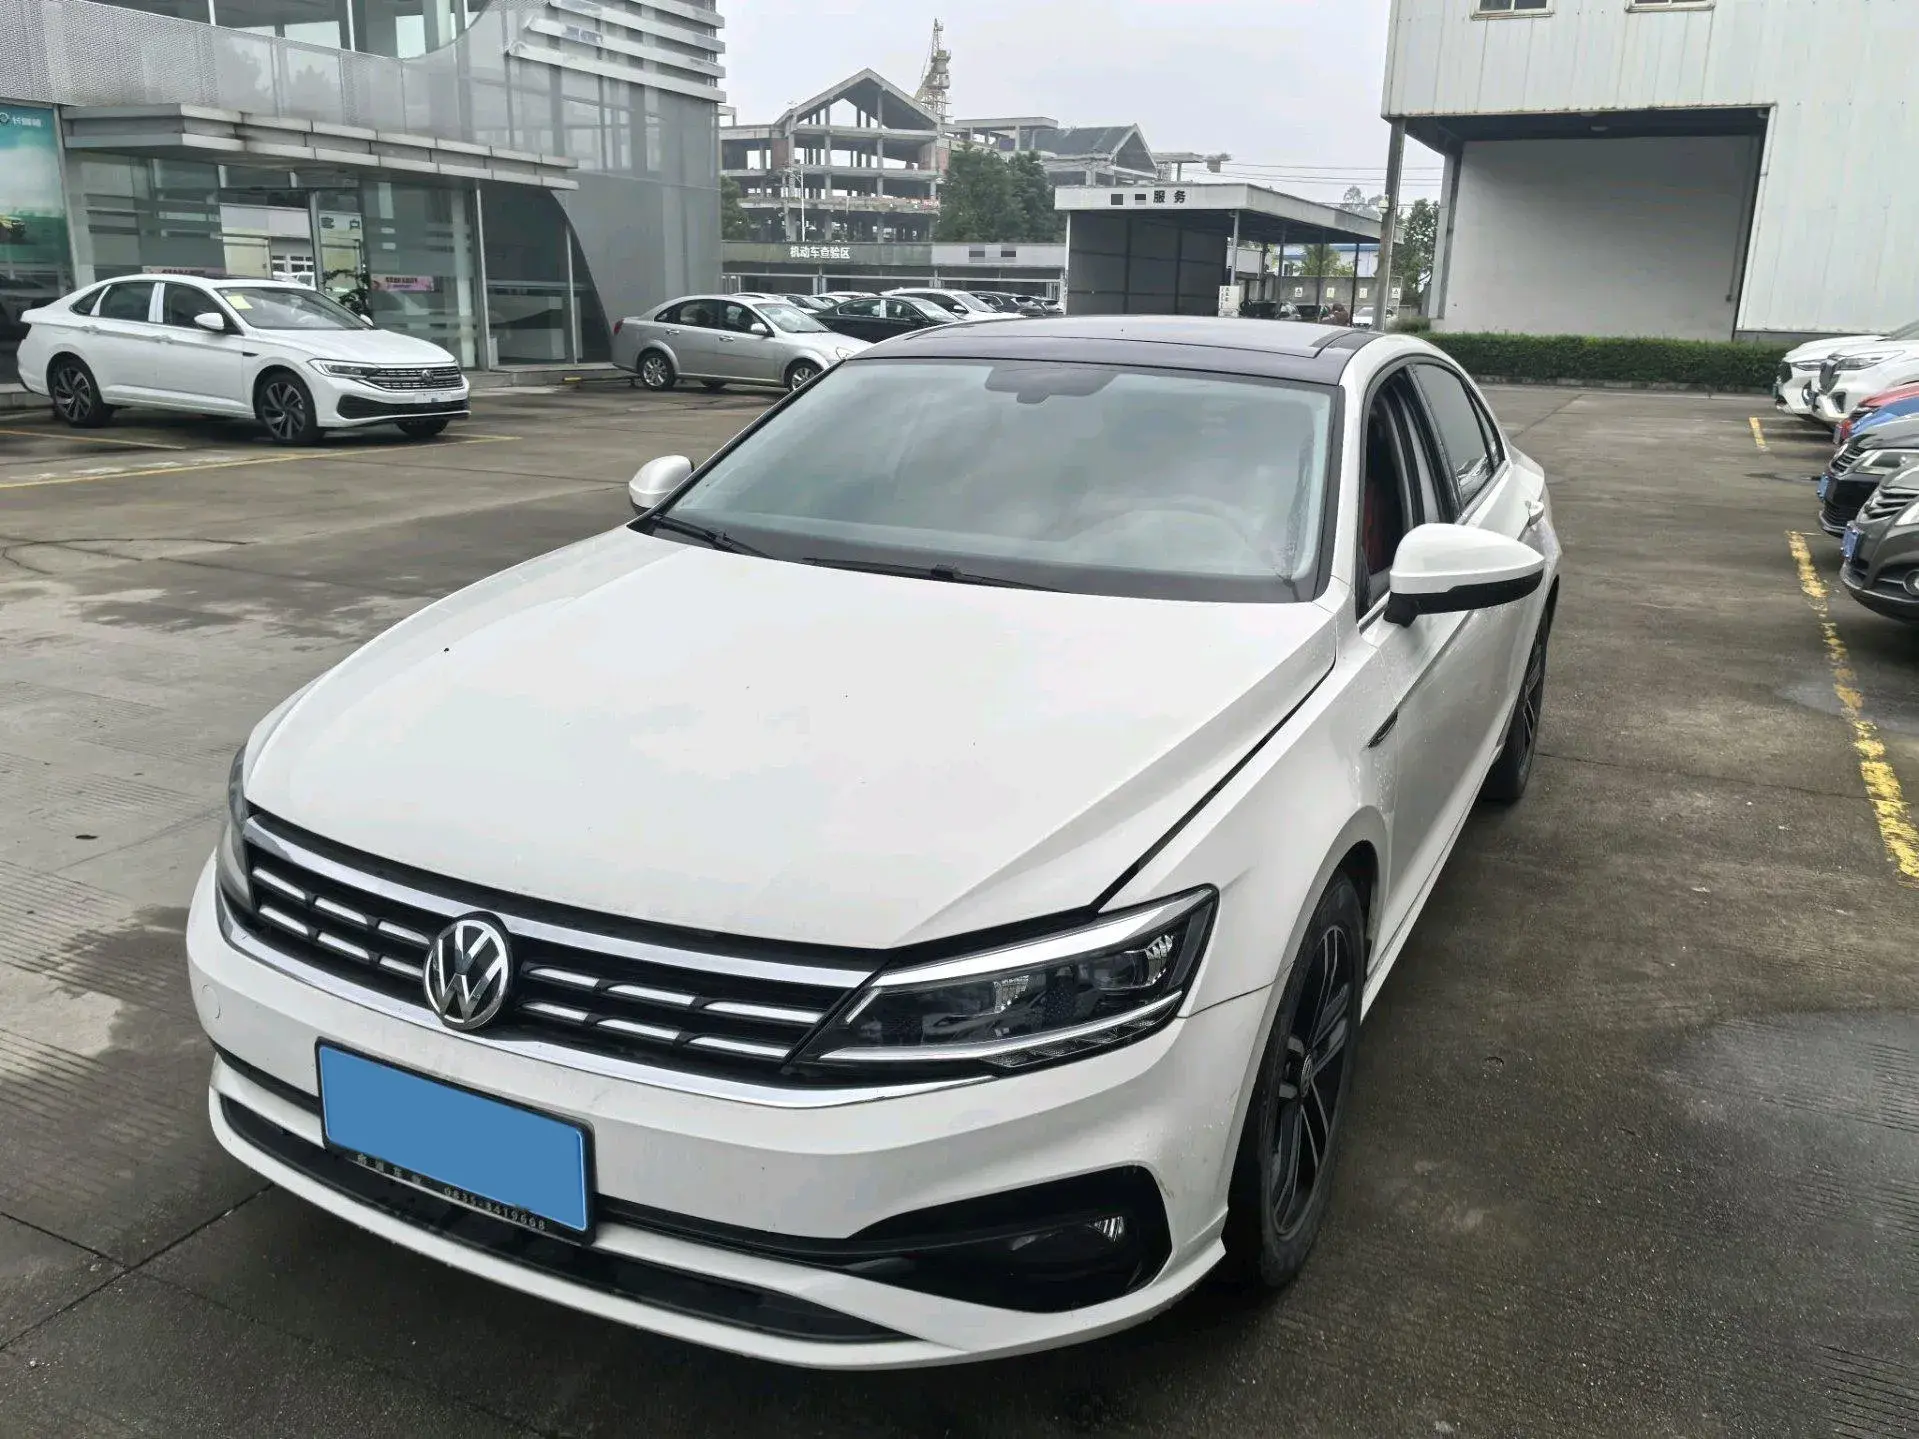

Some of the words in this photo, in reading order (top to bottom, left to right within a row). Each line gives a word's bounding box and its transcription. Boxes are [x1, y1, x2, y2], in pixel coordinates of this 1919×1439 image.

[1153, 190, 1186, 204] 服务
[790, 246, 850, 259] 机动车查验区
